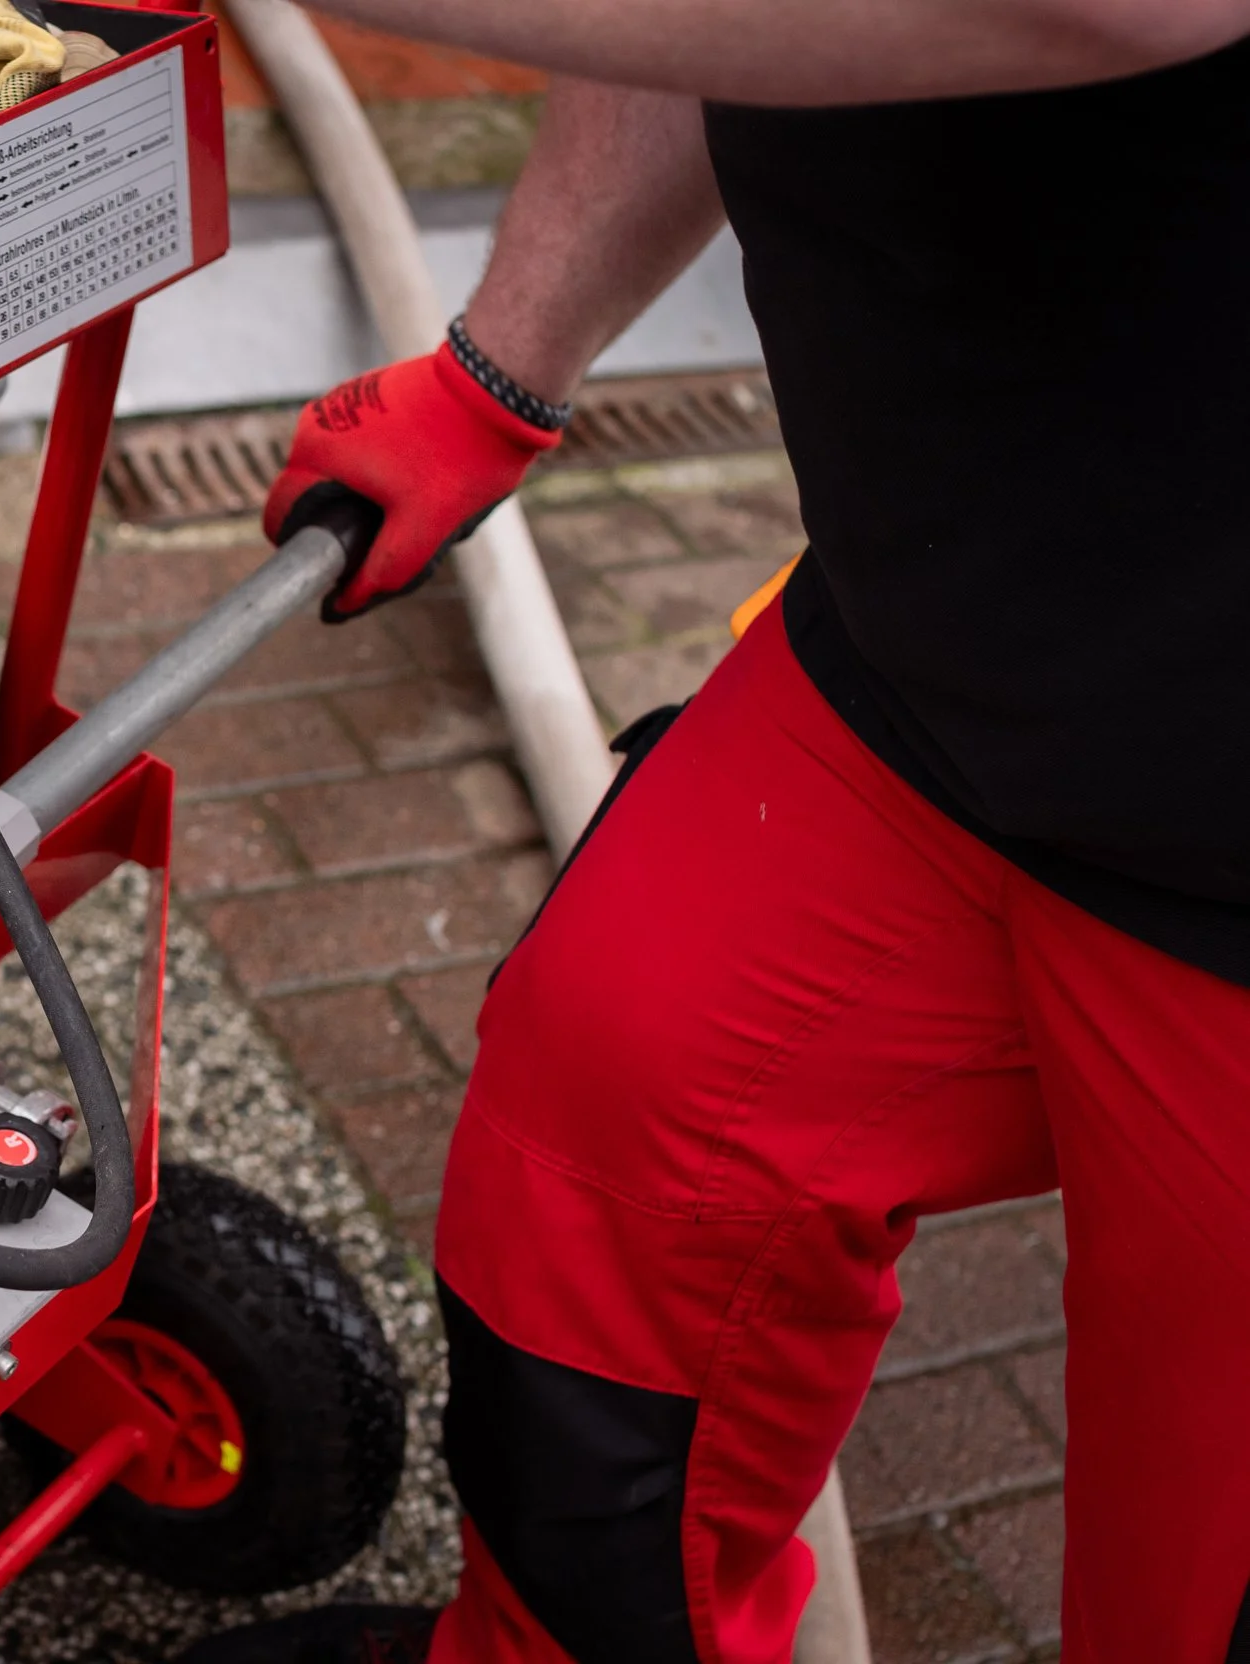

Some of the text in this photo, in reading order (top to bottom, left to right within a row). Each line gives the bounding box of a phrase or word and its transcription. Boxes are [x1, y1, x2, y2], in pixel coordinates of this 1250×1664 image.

[46, 225, 59, 241] mit
[61, 203, 105, 233] Mundstück
[107, 199, 114, 211] in
[24, 263, 28, 272] 7
[12, 304, 19, 315] 27
